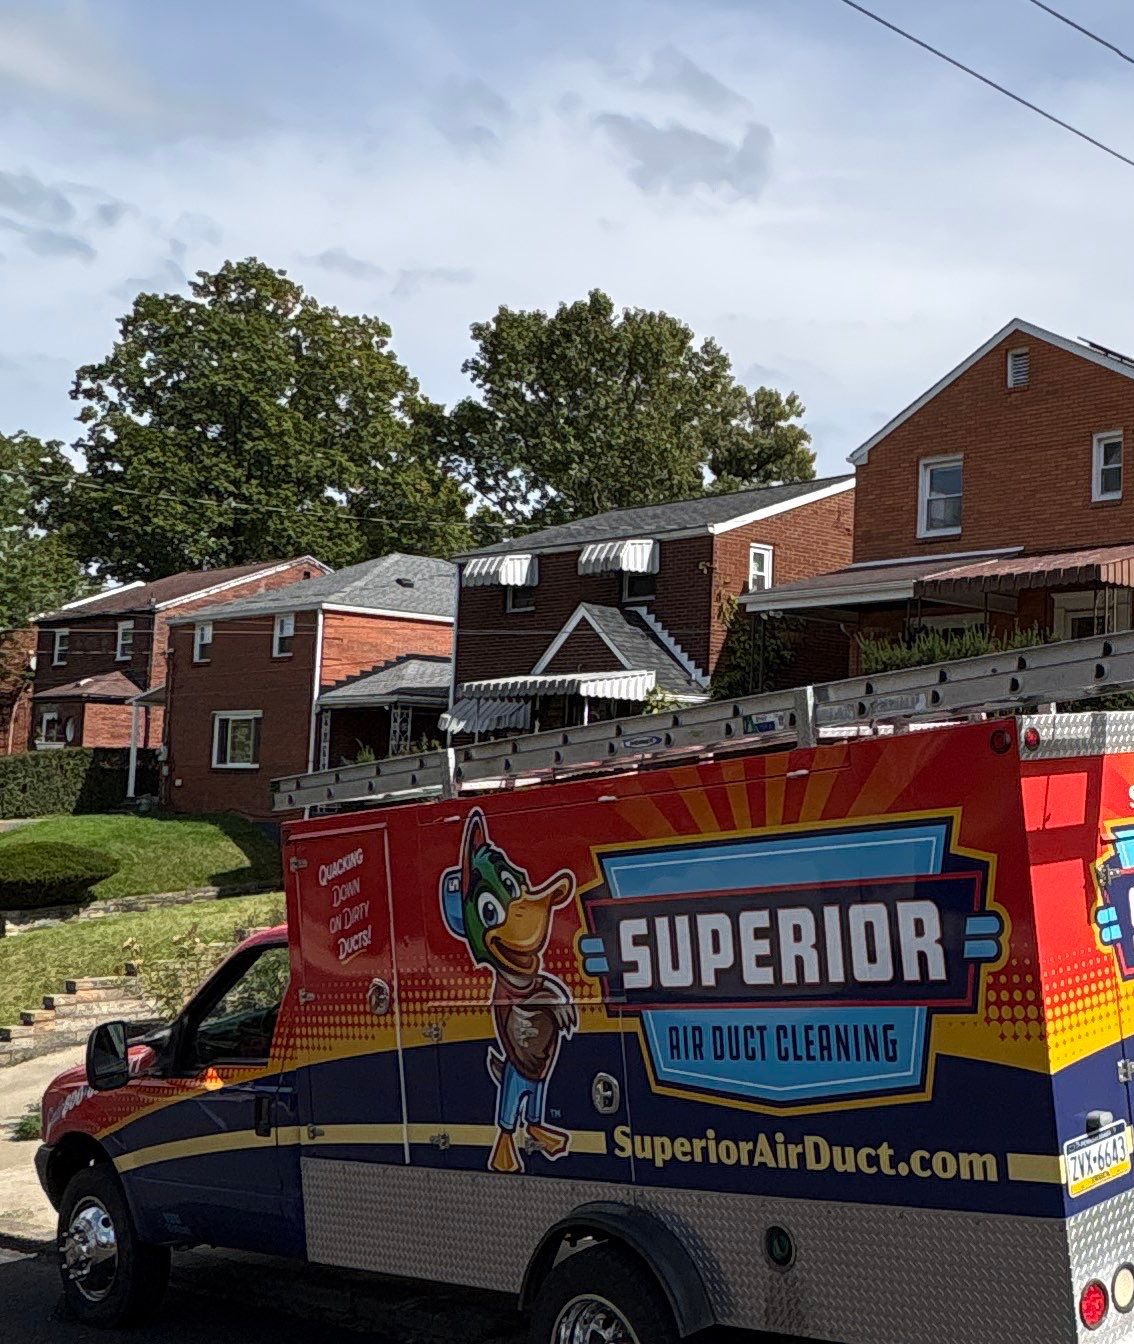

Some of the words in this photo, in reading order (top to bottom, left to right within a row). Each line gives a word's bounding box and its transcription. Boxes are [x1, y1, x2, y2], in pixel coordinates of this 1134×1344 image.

[319, 848, 364, 887] QUACKING
[342, 900, 370, 930] DIRTY
[619, 899, 948, 990] SUPERIOR
[668, 1025, 705, 1061] AIR
[711, 1024, 768, 1062] DUCT
[775, 1024, 898, 1063] CLEANING
[613, 1125, 999, 1182] SuperiorAirDuct.com
